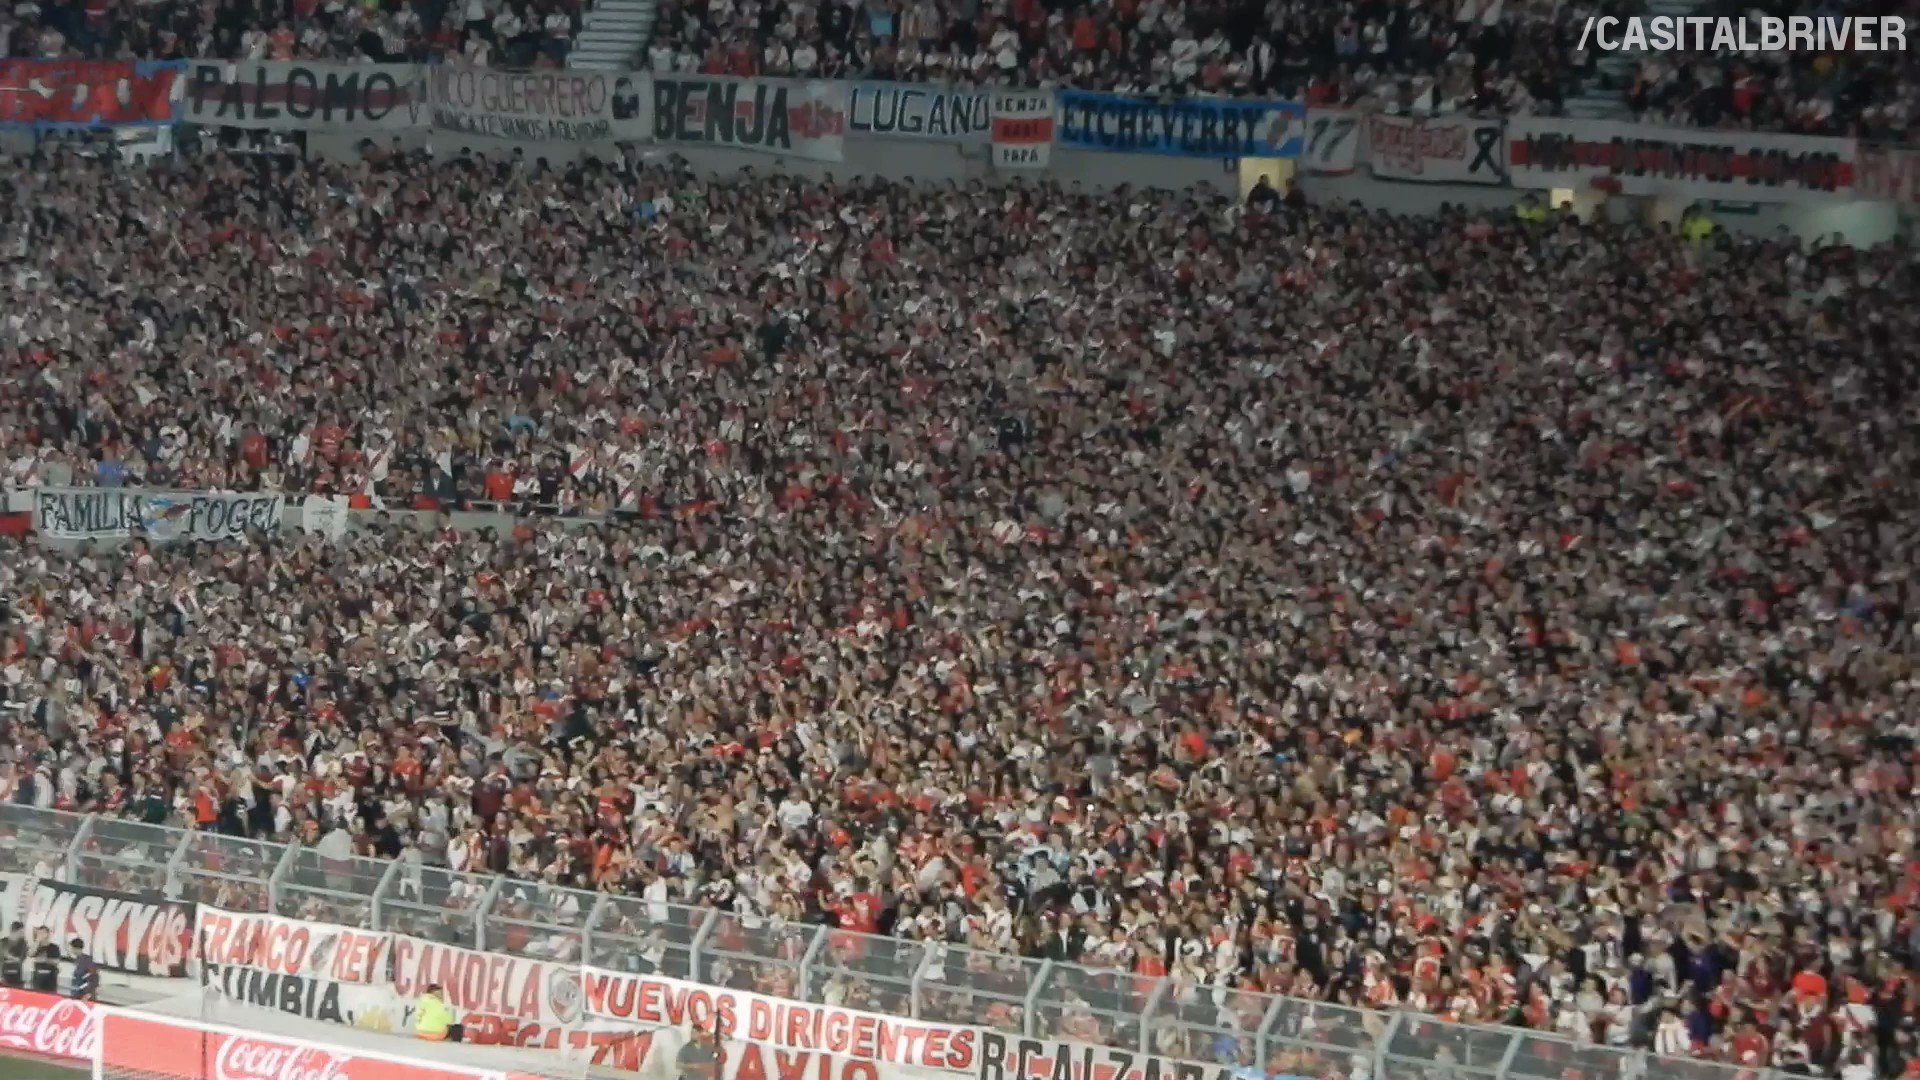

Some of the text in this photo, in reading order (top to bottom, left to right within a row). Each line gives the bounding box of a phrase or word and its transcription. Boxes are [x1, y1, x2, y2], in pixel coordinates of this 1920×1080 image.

[191, 65, 397, 122] PALOMO
[482, 74, 607, 118] GUERRERO
[654, 79, 792, 149] BENJA
[849, 86, 991, 136] LUGANO
[1062, 98, 1266, 154] ETCHEVERRY
[39, 491, 148, 533] FAMILIA
[25, 883, 159, 971] PASKY
[200, 912, 387, 984] FRANCO REY
[394, 937, 542, 1021] CANDELA
[583, 971, 976, 1071] NUEVOS DIRIGENTES
